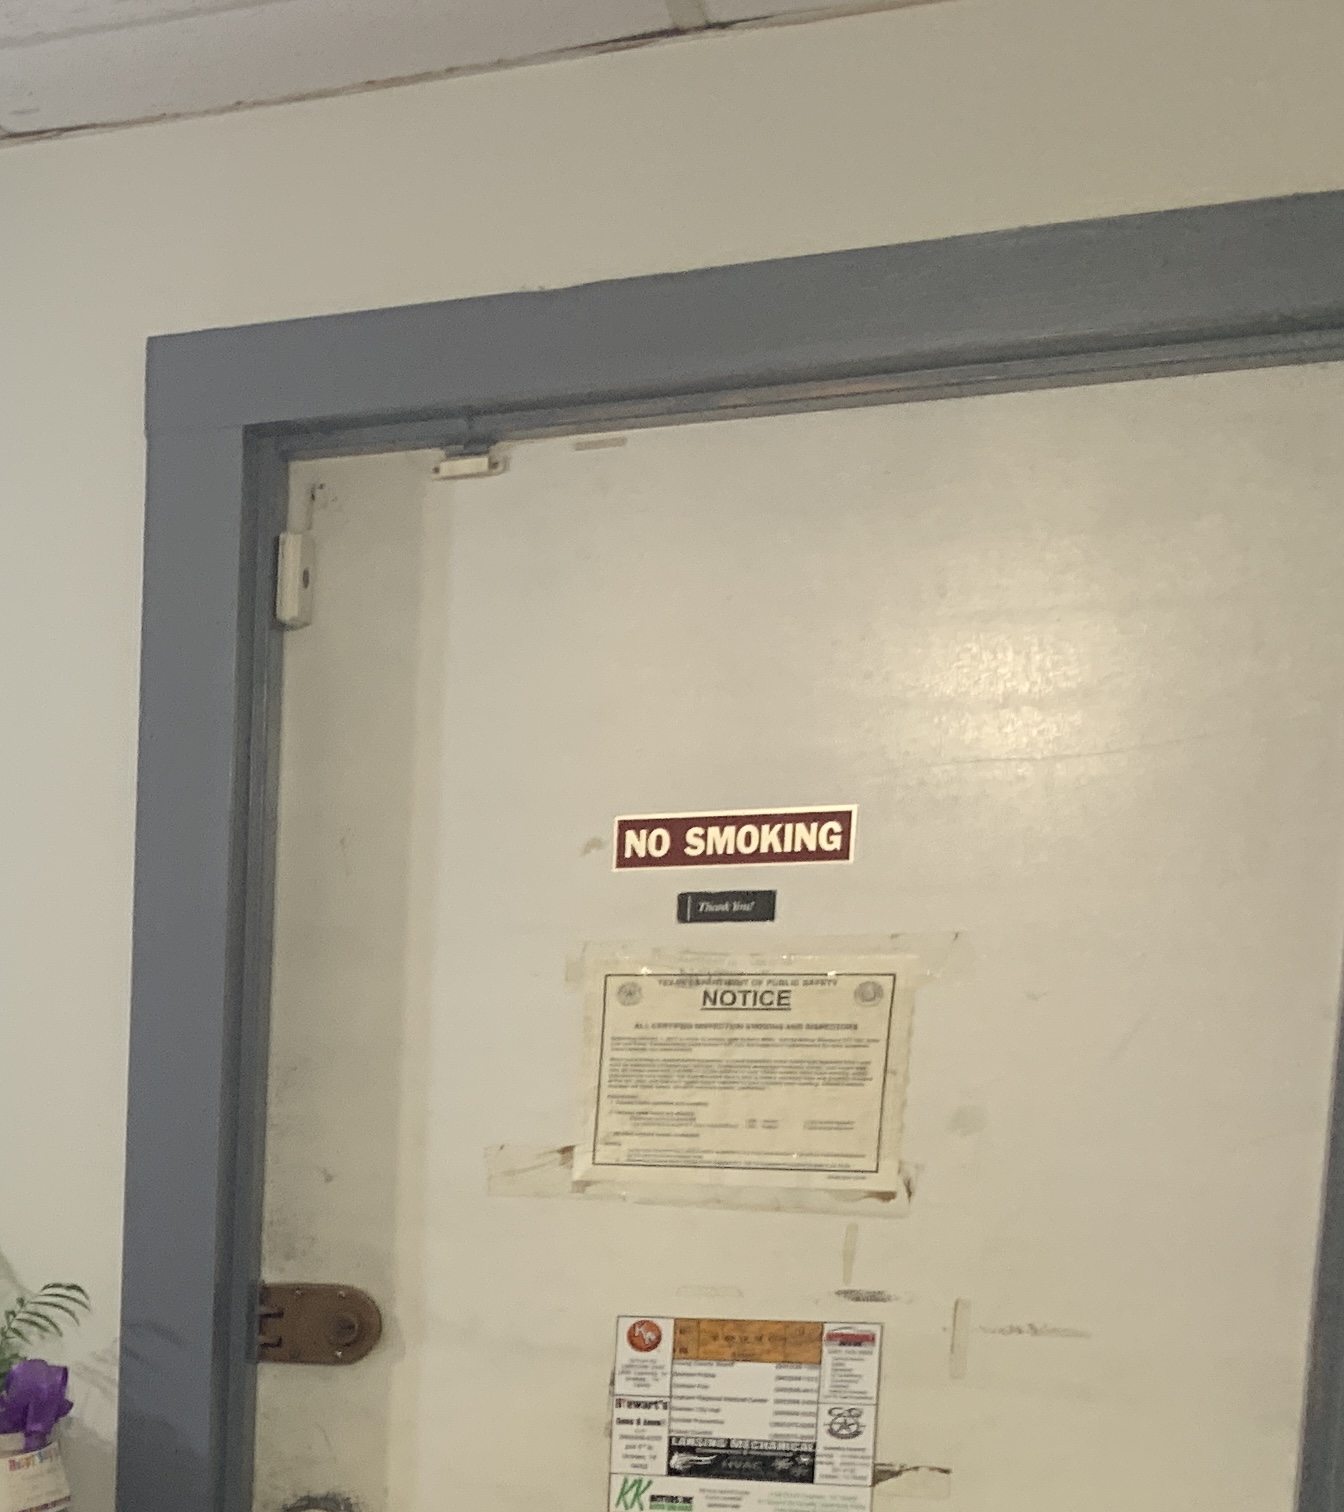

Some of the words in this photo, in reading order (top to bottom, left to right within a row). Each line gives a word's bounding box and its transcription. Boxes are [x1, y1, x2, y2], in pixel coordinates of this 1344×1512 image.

[623, 828, 671, 859] NO
[683, 821, 843, 856] SMOKING
[698, 901, 730, 912] Thank
[702, 989, 792, 1007] NOTICE
[615, 1475, 653, 1511] KK
